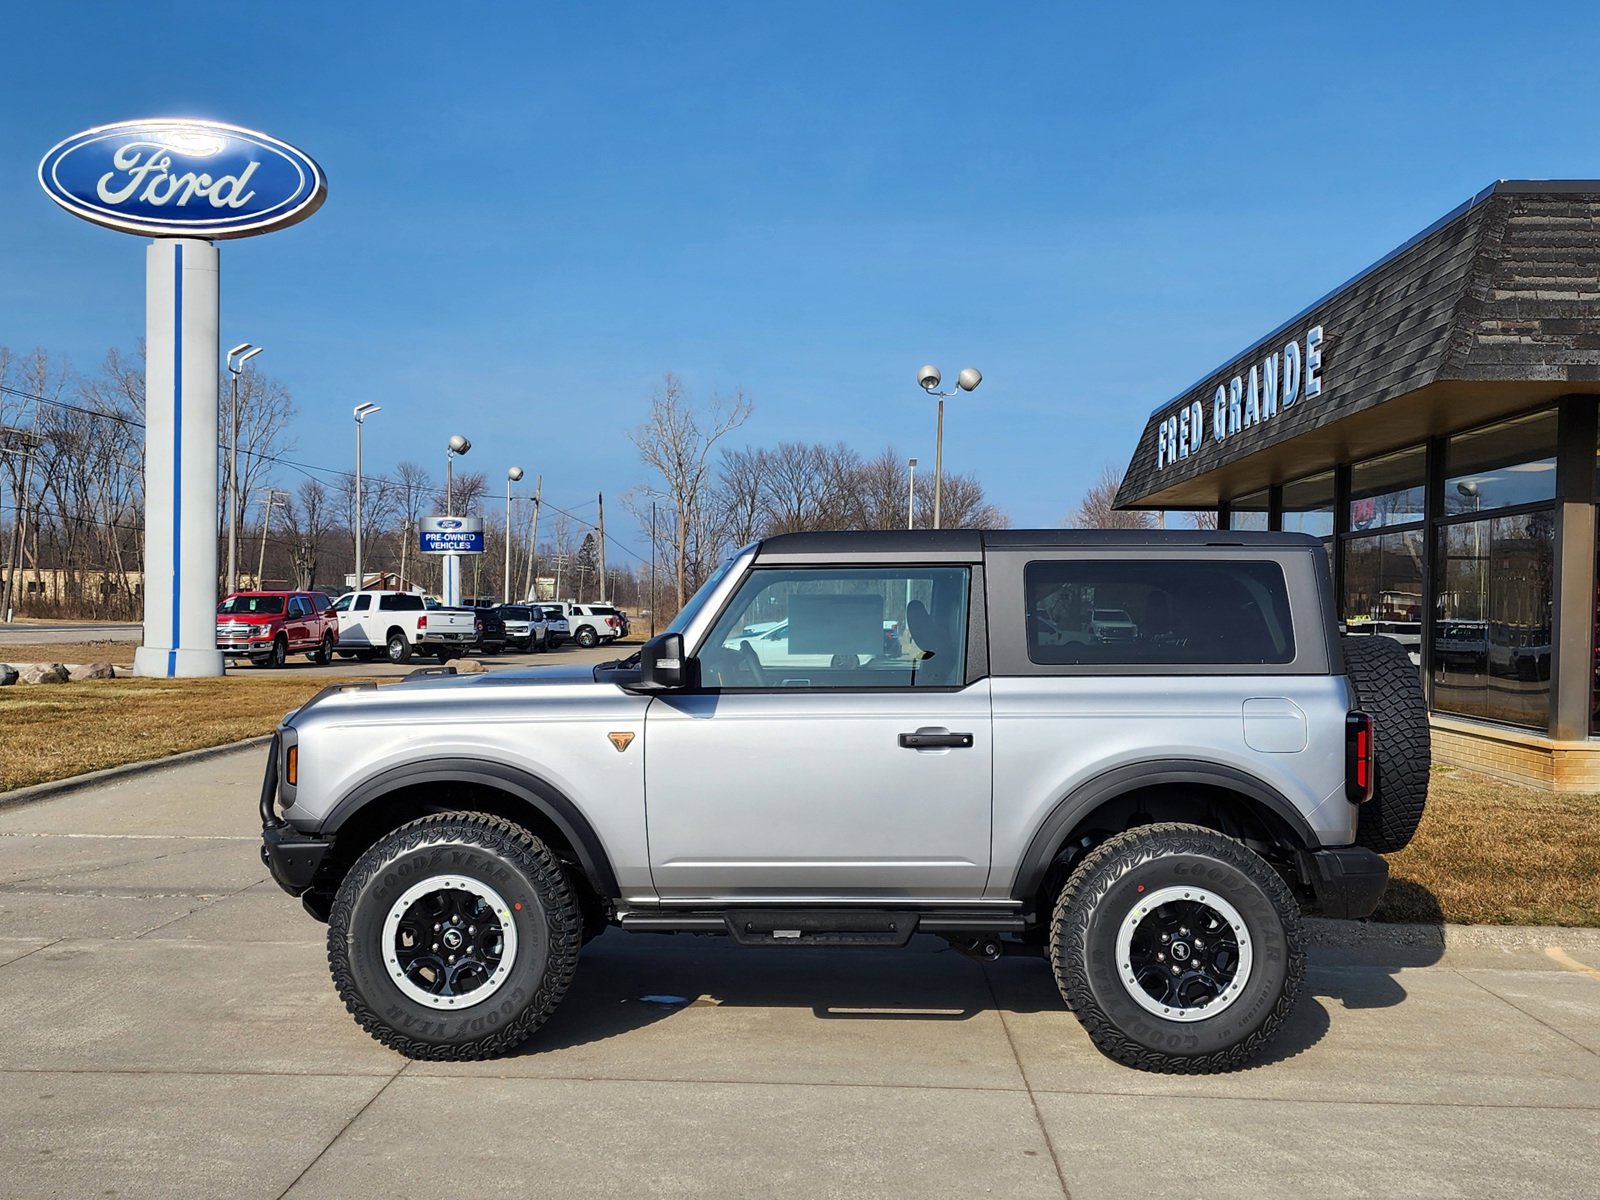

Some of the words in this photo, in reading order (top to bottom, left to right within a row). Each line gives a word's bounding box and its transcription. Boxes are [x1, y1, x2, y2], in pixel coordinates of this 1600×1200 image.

[97, 140, 261, 209] Ford
[1158, 400, 1203, 470] FRED
[1213, 325, 1323, 443] GRANDE
[425, 533, 476, 541] PRE-OWNED
